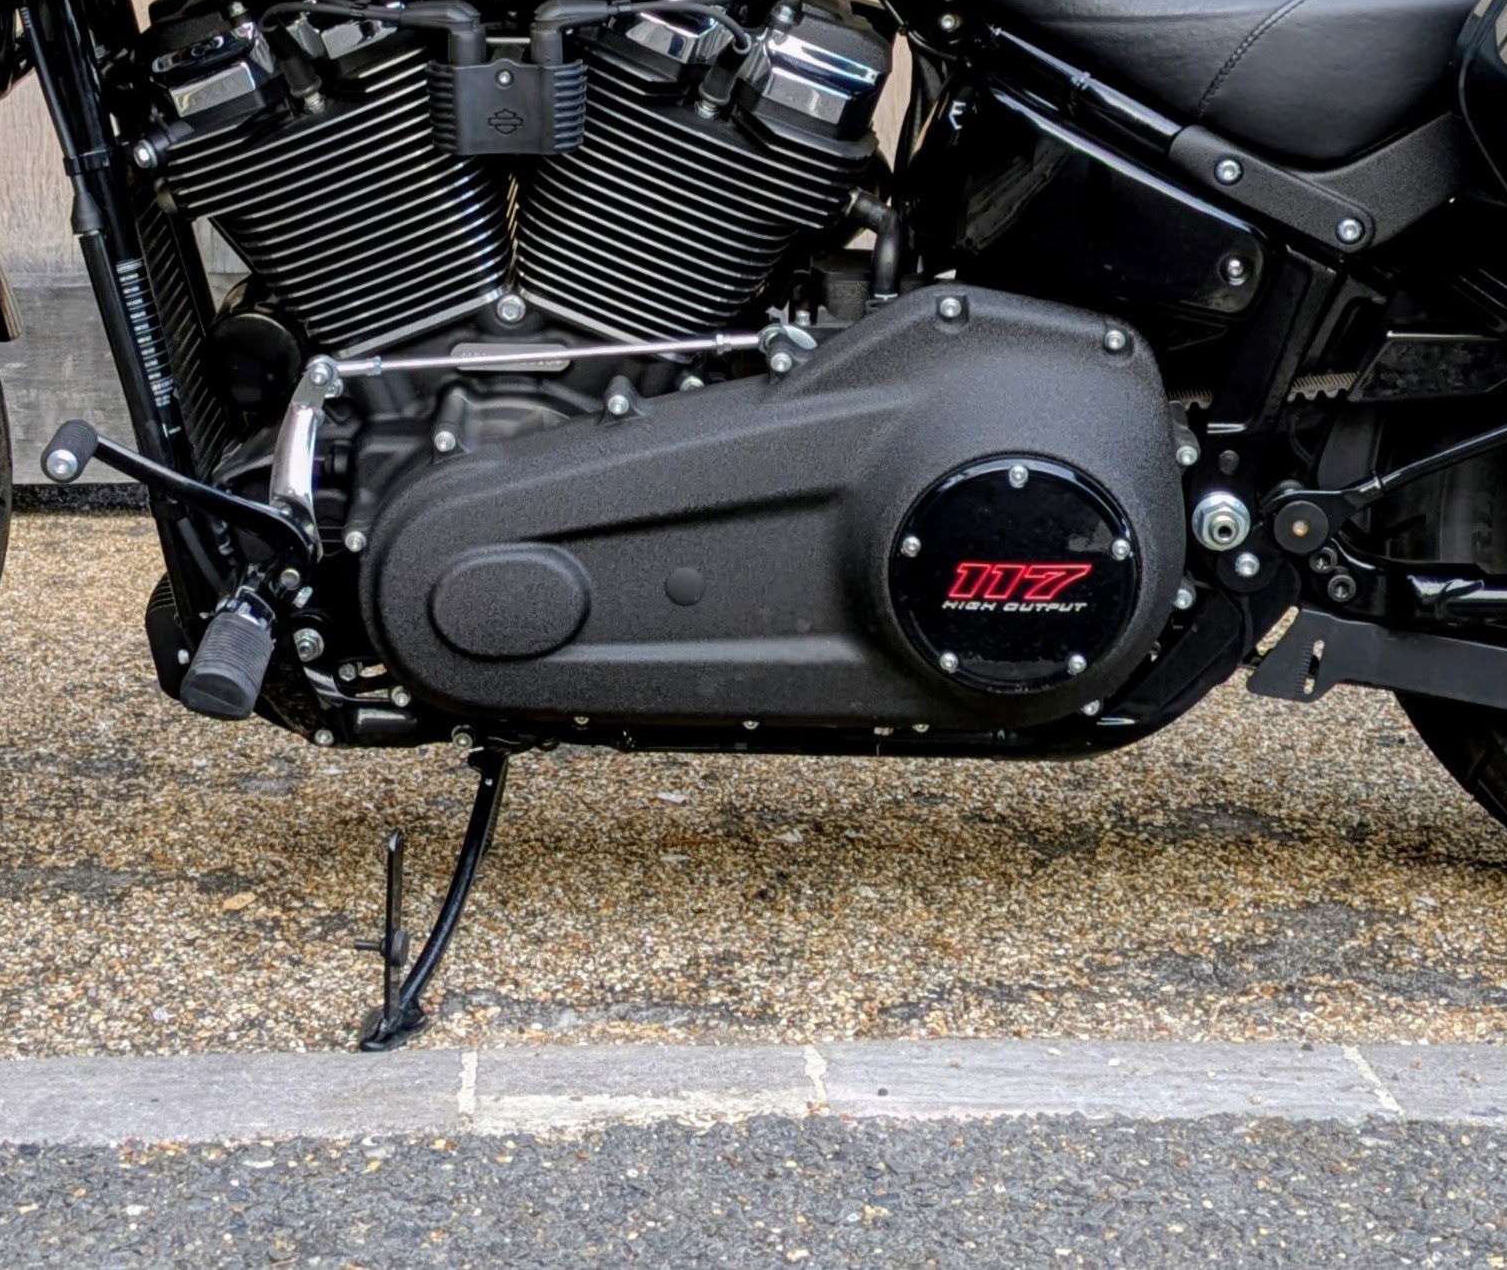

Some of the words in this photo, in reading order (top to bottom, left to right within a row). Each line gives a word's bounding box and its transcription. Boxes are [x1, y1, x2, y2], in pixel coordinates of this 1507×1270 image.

[947, 562, 1093, 600] 117
[942, 601, 997, 611] HIGH
[1003, 602, 1088, 613] OUTPUT
